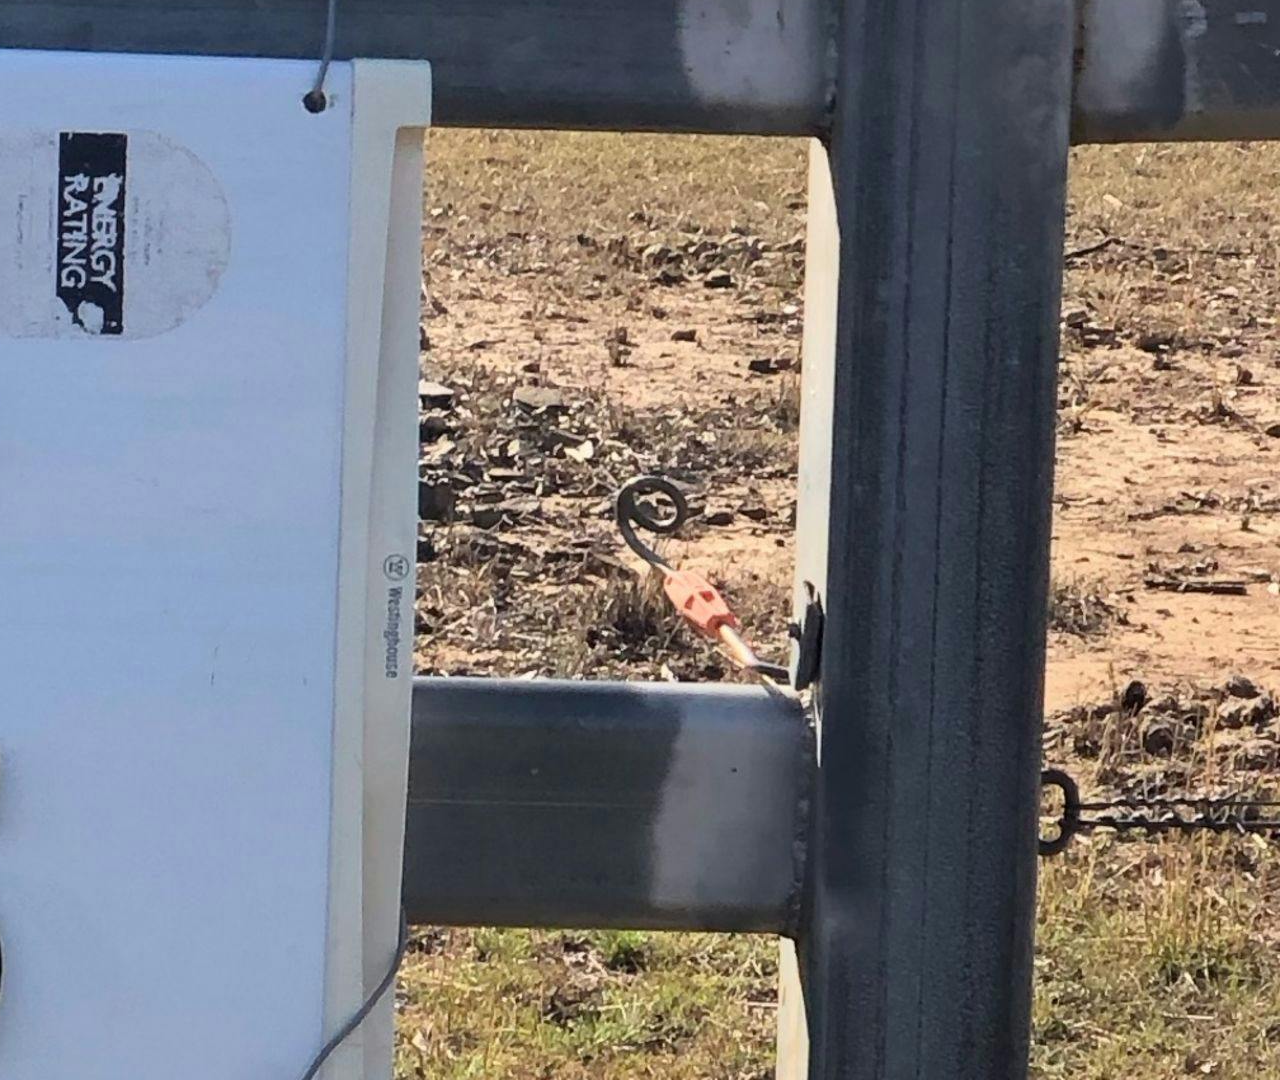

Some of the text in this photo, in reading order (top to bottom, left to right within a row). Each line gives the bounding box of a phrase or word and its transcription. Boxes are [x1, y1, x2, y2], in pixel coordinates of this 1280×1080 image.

[60, 174, 90, 289] RATING
[90, 173, 124, 291] ENERGY
[383, 586, 403, 679] Westinghouse
